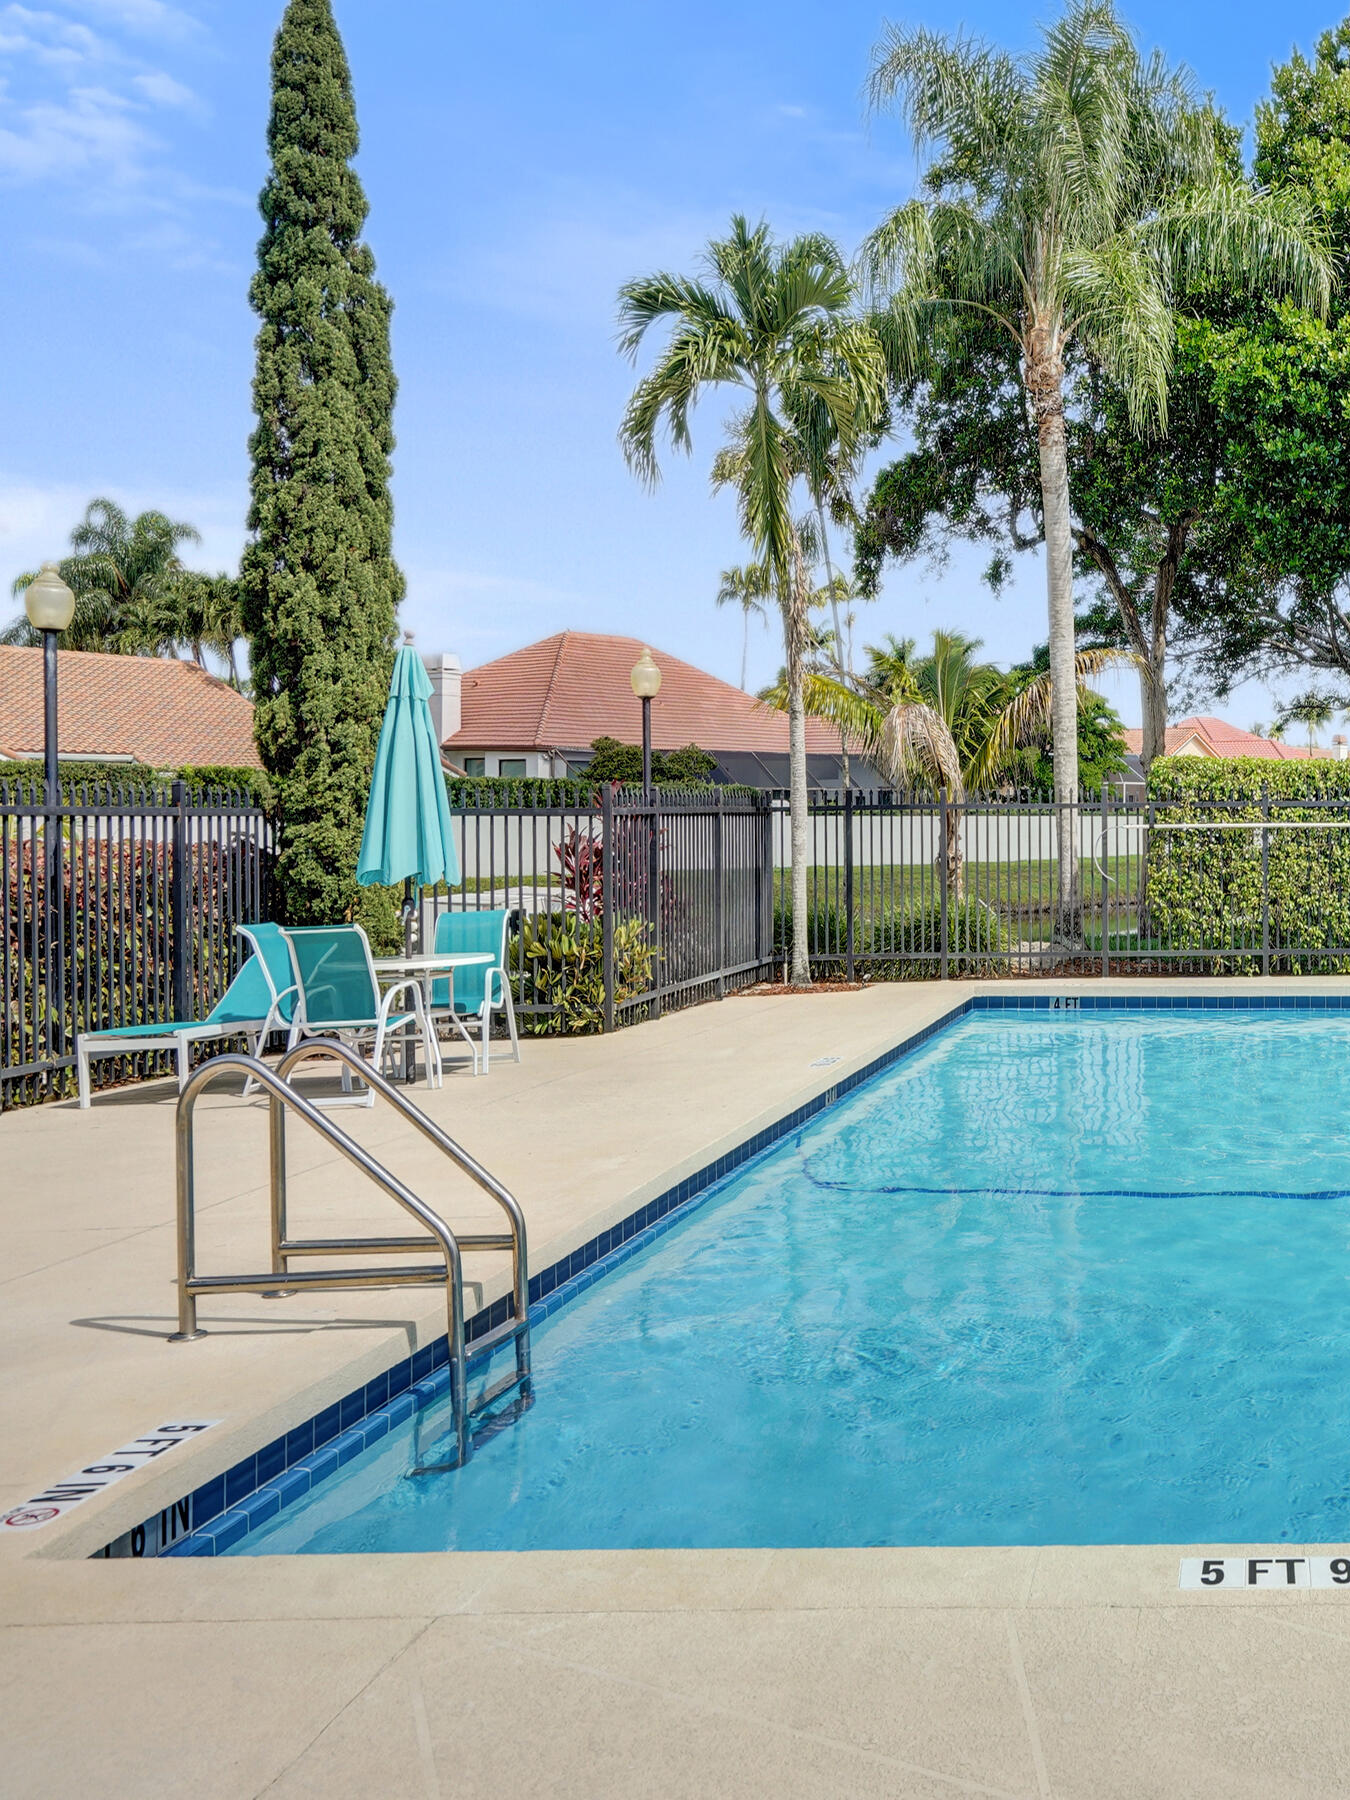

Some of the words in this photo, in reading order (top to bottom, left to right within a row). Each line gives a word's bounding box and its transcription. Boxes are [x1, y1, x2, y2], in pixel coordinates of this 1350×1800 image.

[1054, 996, 1060, 1008] 4
[1065, 996, 1078, 1008] FT
[157, 1425, 208, 1433] 5
[114, 1438, 183, 1457] FT
[82, 1464, 135, 1474] 6
[27, 1482, 109, 1503] IN
[162, 1495, 190, 1548] IN
[1200, 1560, 1225, 1585] 5
[1248, 1559, 1305, 1584] FT
